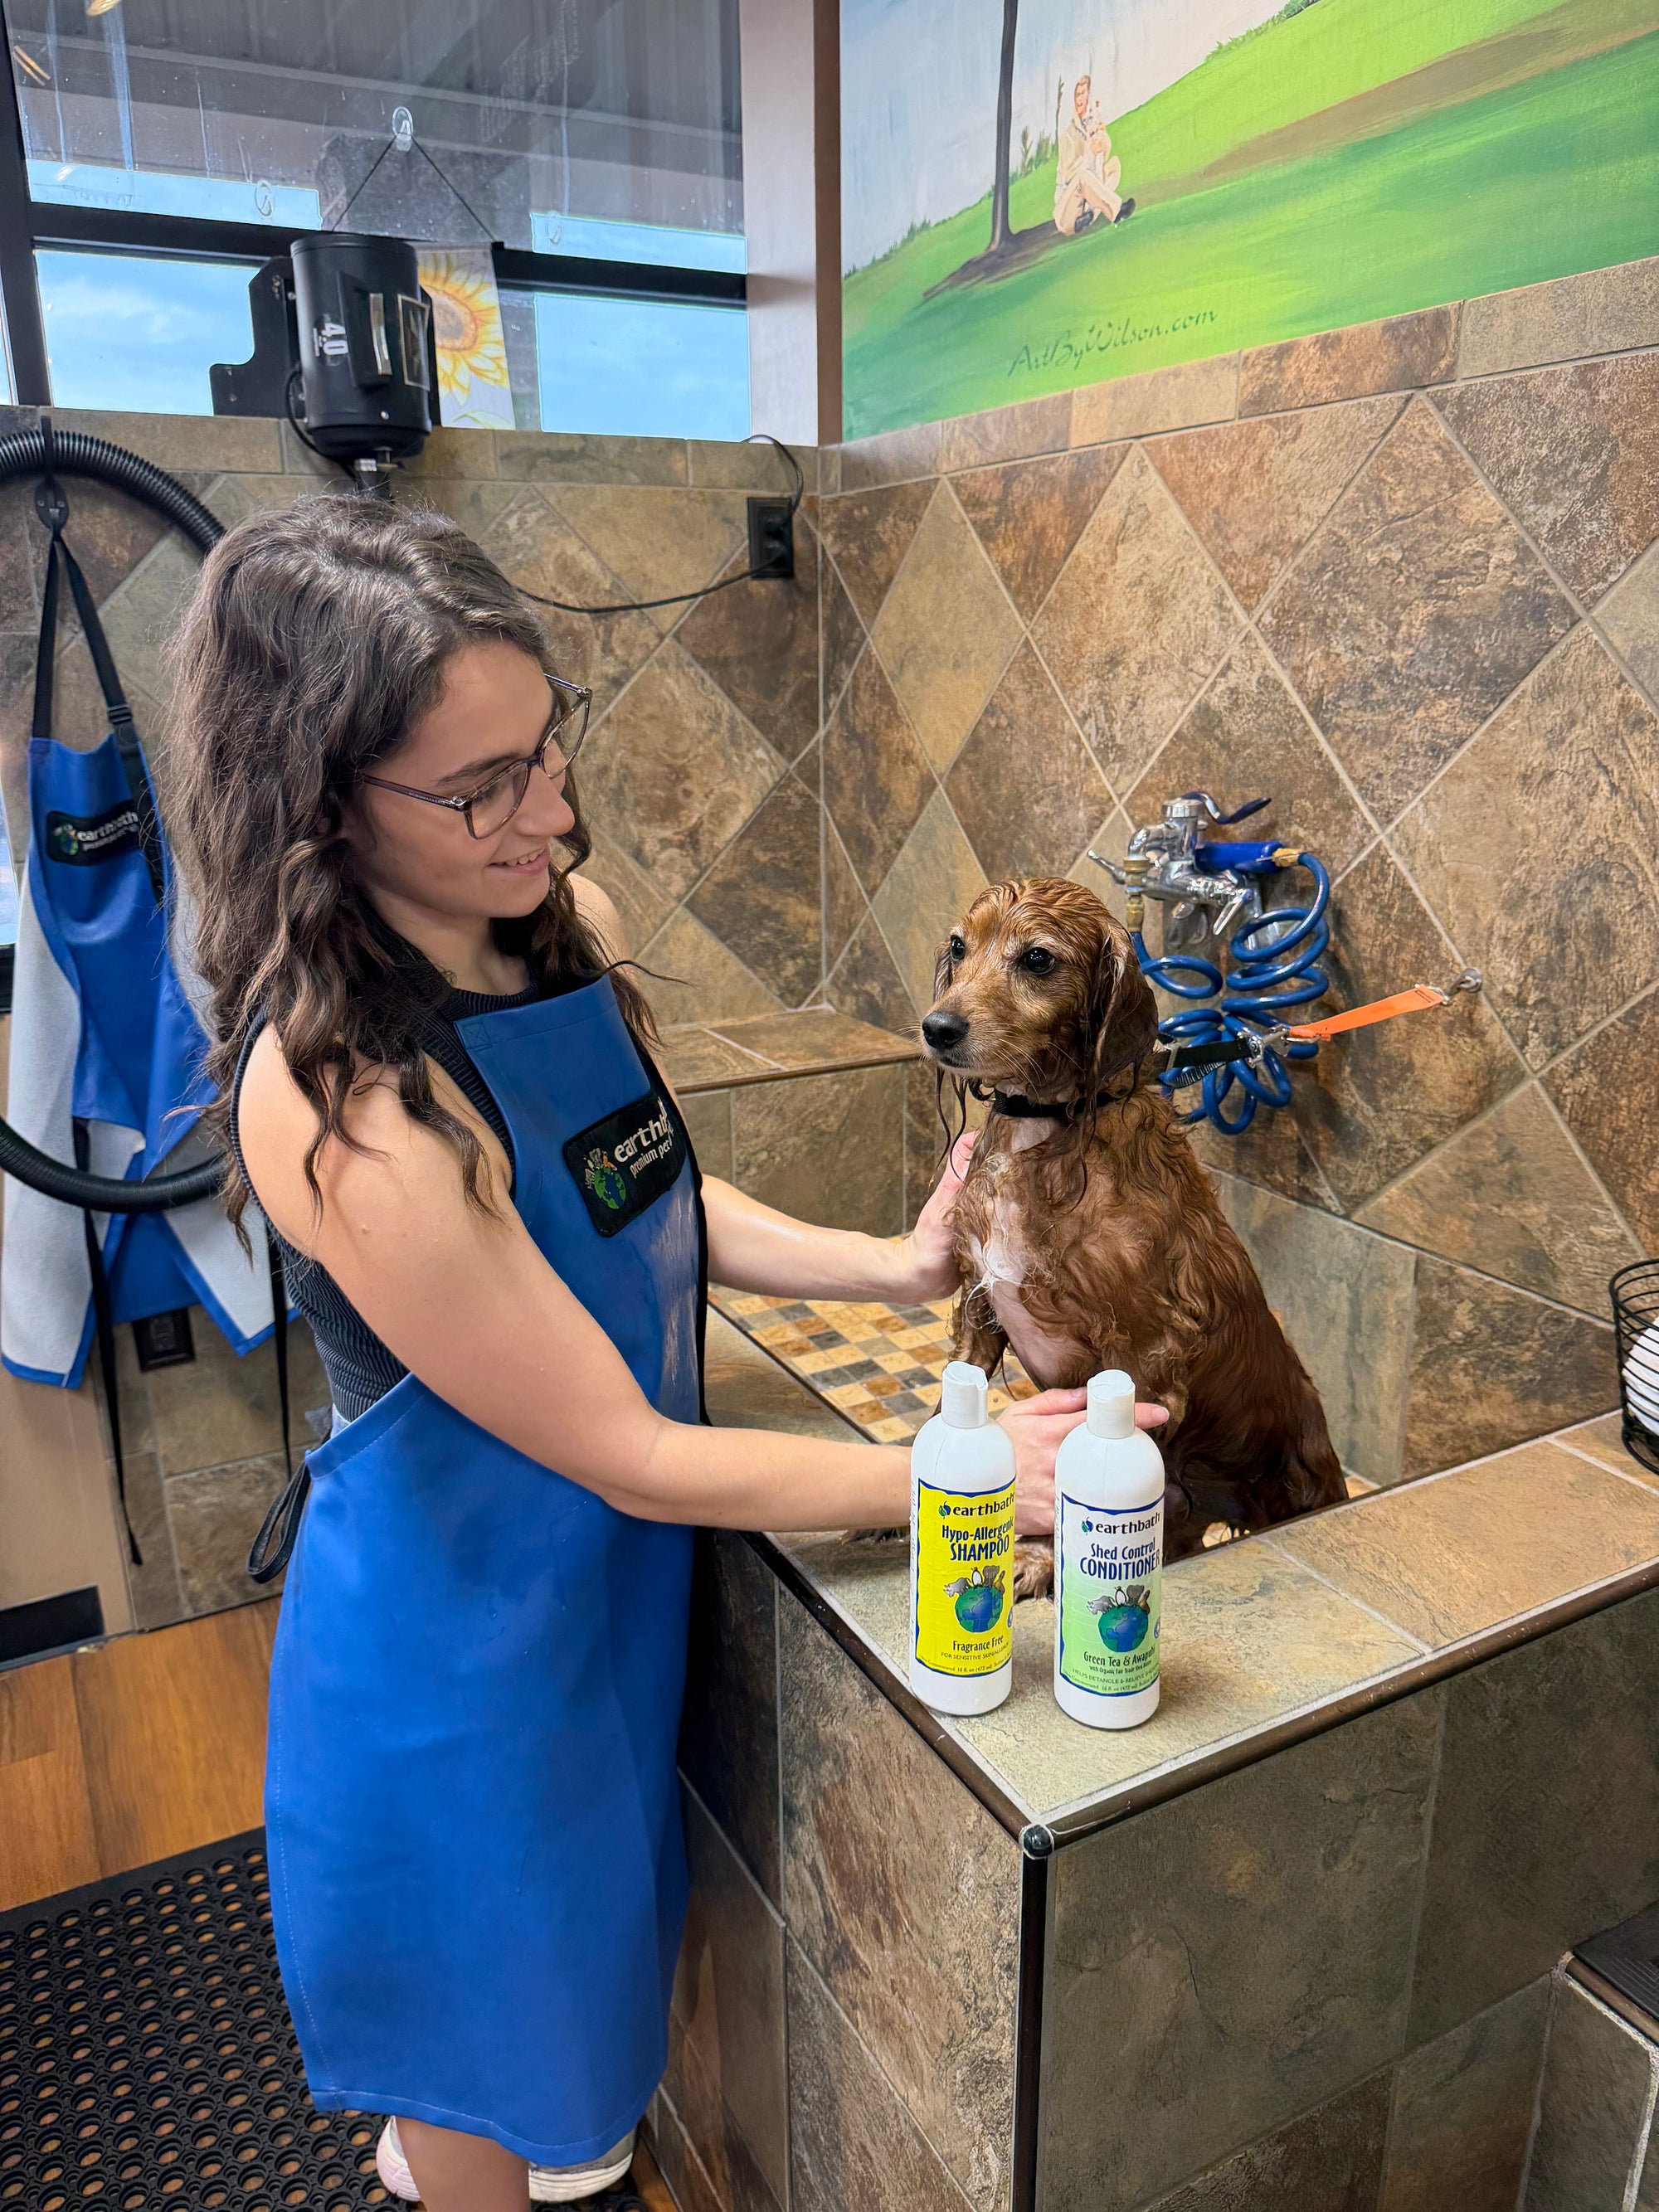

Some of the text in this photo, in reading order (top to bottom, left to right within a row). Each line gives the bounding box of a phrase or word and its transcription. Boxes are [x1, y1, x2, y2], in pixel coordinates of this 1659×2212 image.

[1007, 309, 1218, 377] ArtByWilson.com
[630, 1149, 658, 1179] premium
[952, 1491, 1015, 1517] earthbath
[1095, 1512, 1160, 1534] earthbath
[950, 1534, 1010, 1561] SHAMPOO
[1090, 1536, 1155, 1561] Shed Control
[1079, 1548, 1160, 1581] CONDITIONER
[952, 1635, 1004, 1653] Fragrance Free
[1083, 1651, 1106, 1666] Green
[1108, 1655, 1121, 1667] Tea
[1122, 1655, 1131, 1665] &
[1072, 1667, 1088, 1679] HELPS
[1088, 1675, 1119, 1685] DETANGLE
